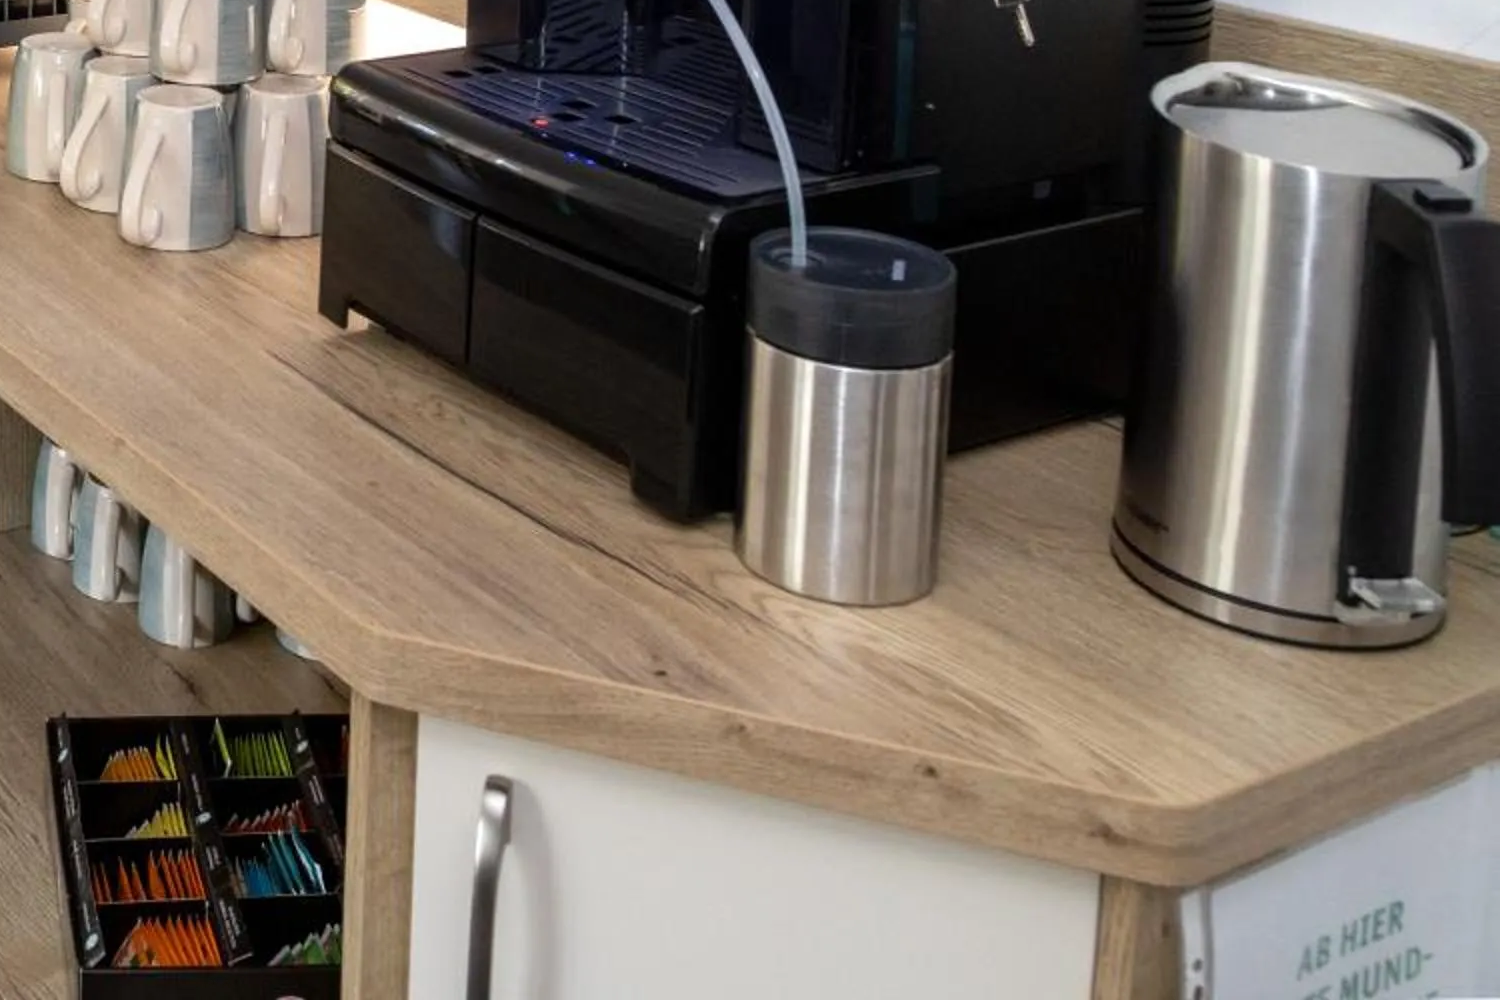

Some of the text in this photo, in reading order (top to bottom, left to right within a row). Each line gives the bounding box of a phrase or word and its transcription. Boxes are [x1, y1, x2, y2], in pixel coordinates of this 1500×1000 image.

[1297, 900, 1405, 981] AB HIER
[1340, 945, 1435, 1000] MUND-
